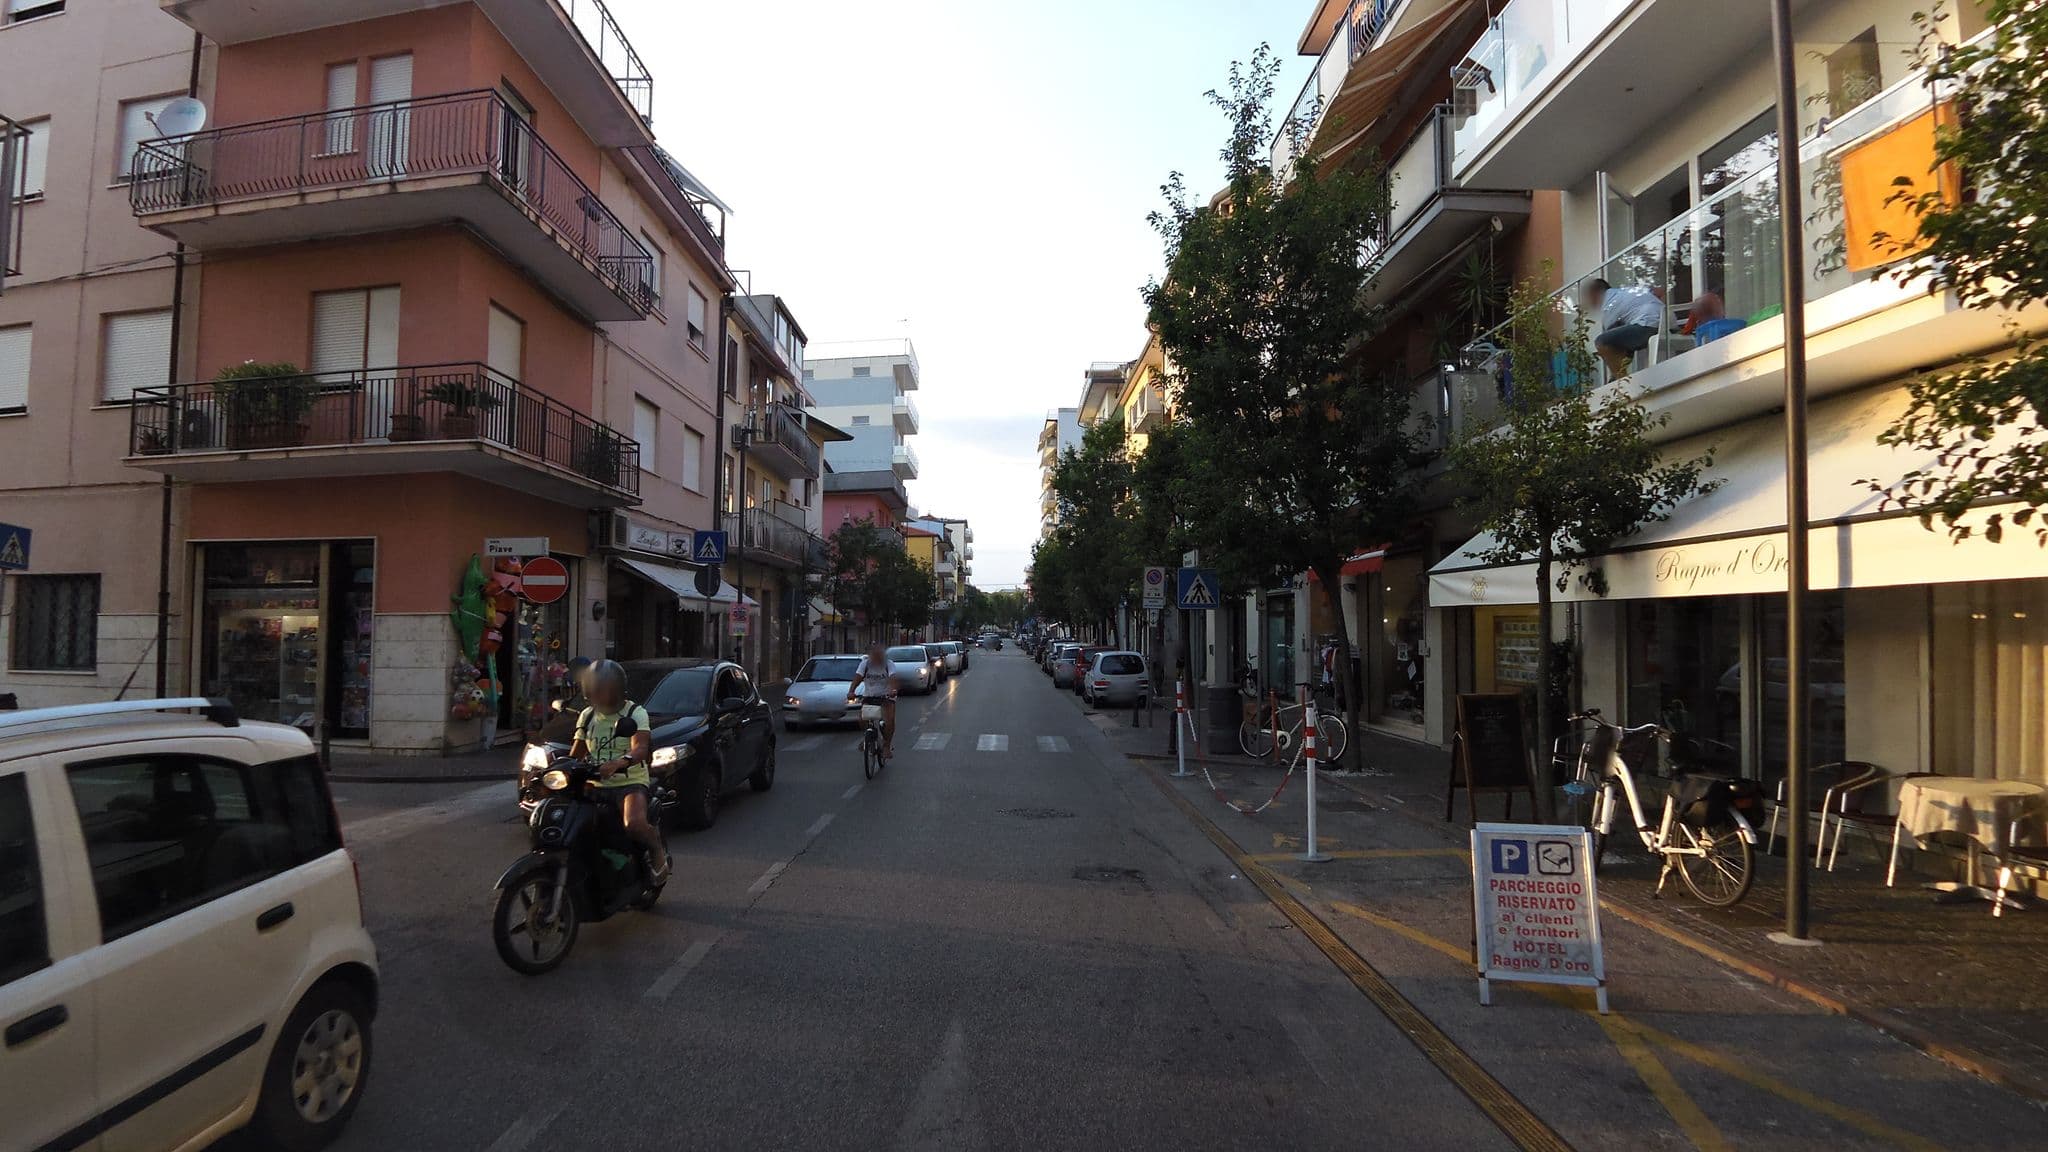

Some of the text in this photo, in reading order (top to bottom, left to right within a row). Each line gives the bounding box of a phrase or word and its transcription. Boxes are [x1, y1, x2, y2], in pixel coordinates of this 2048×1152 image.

[489, 545, 513, 553] Piave
[1656, 550, 1721, 591] Ragno
[1500, 844, 1521, 870] P
[1490, 879, 1582, 895] PARCHEGGIO
[1497, 896, 1576, 911] RISERVATO
[1502, 913, 1574, 925] ai clienti
[1498, 926, 1579, 939] e fornitori
[1513, 941, 1567, 955] HOTEL
[1492, 954, 1590, 972] Ragno D'oro
